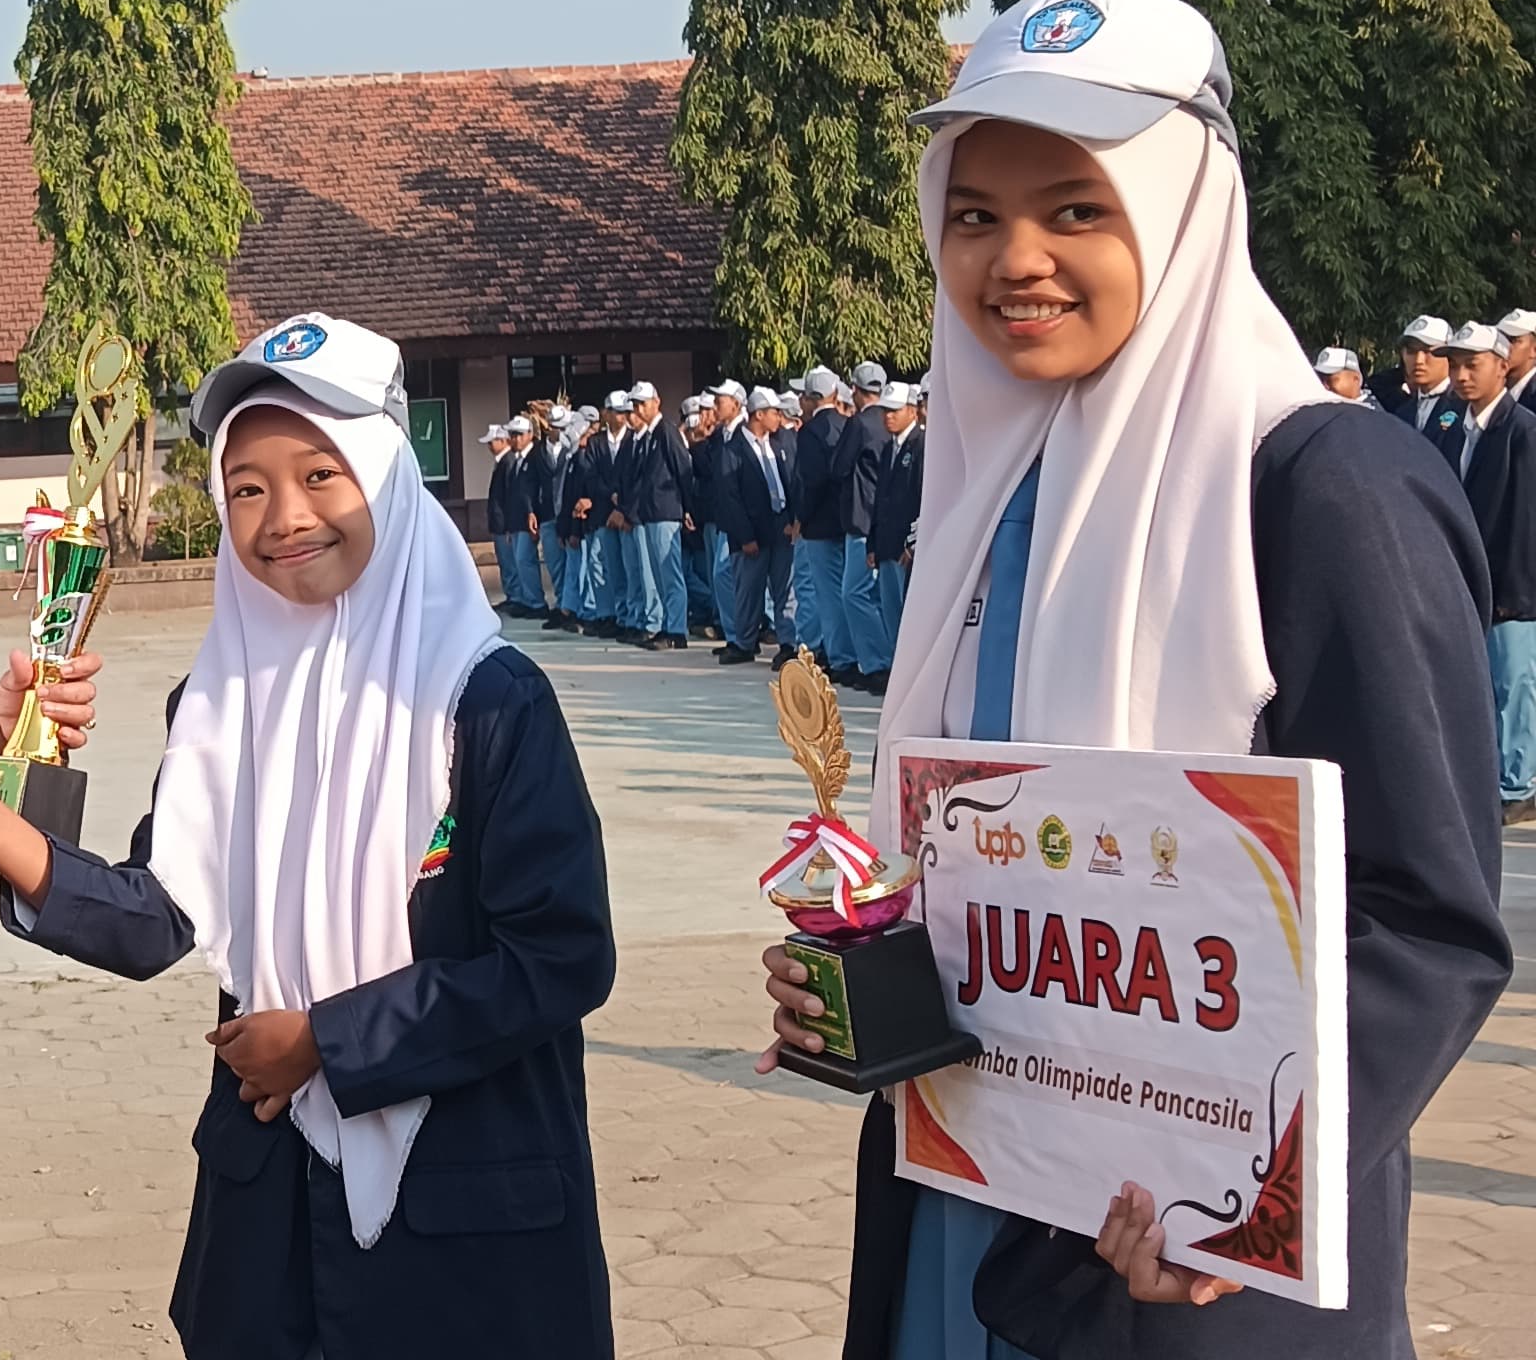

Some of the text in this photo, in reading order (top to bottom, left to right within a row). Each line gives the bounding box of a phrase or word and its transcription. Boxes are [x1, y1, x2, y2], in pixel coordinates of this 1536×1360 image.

[958, 901, 1240, 1032] JUARA 3
[1024, 1054, 1133, 1105] Olimpiade
[1139, 1080, 1254, 1133] Pancasila
